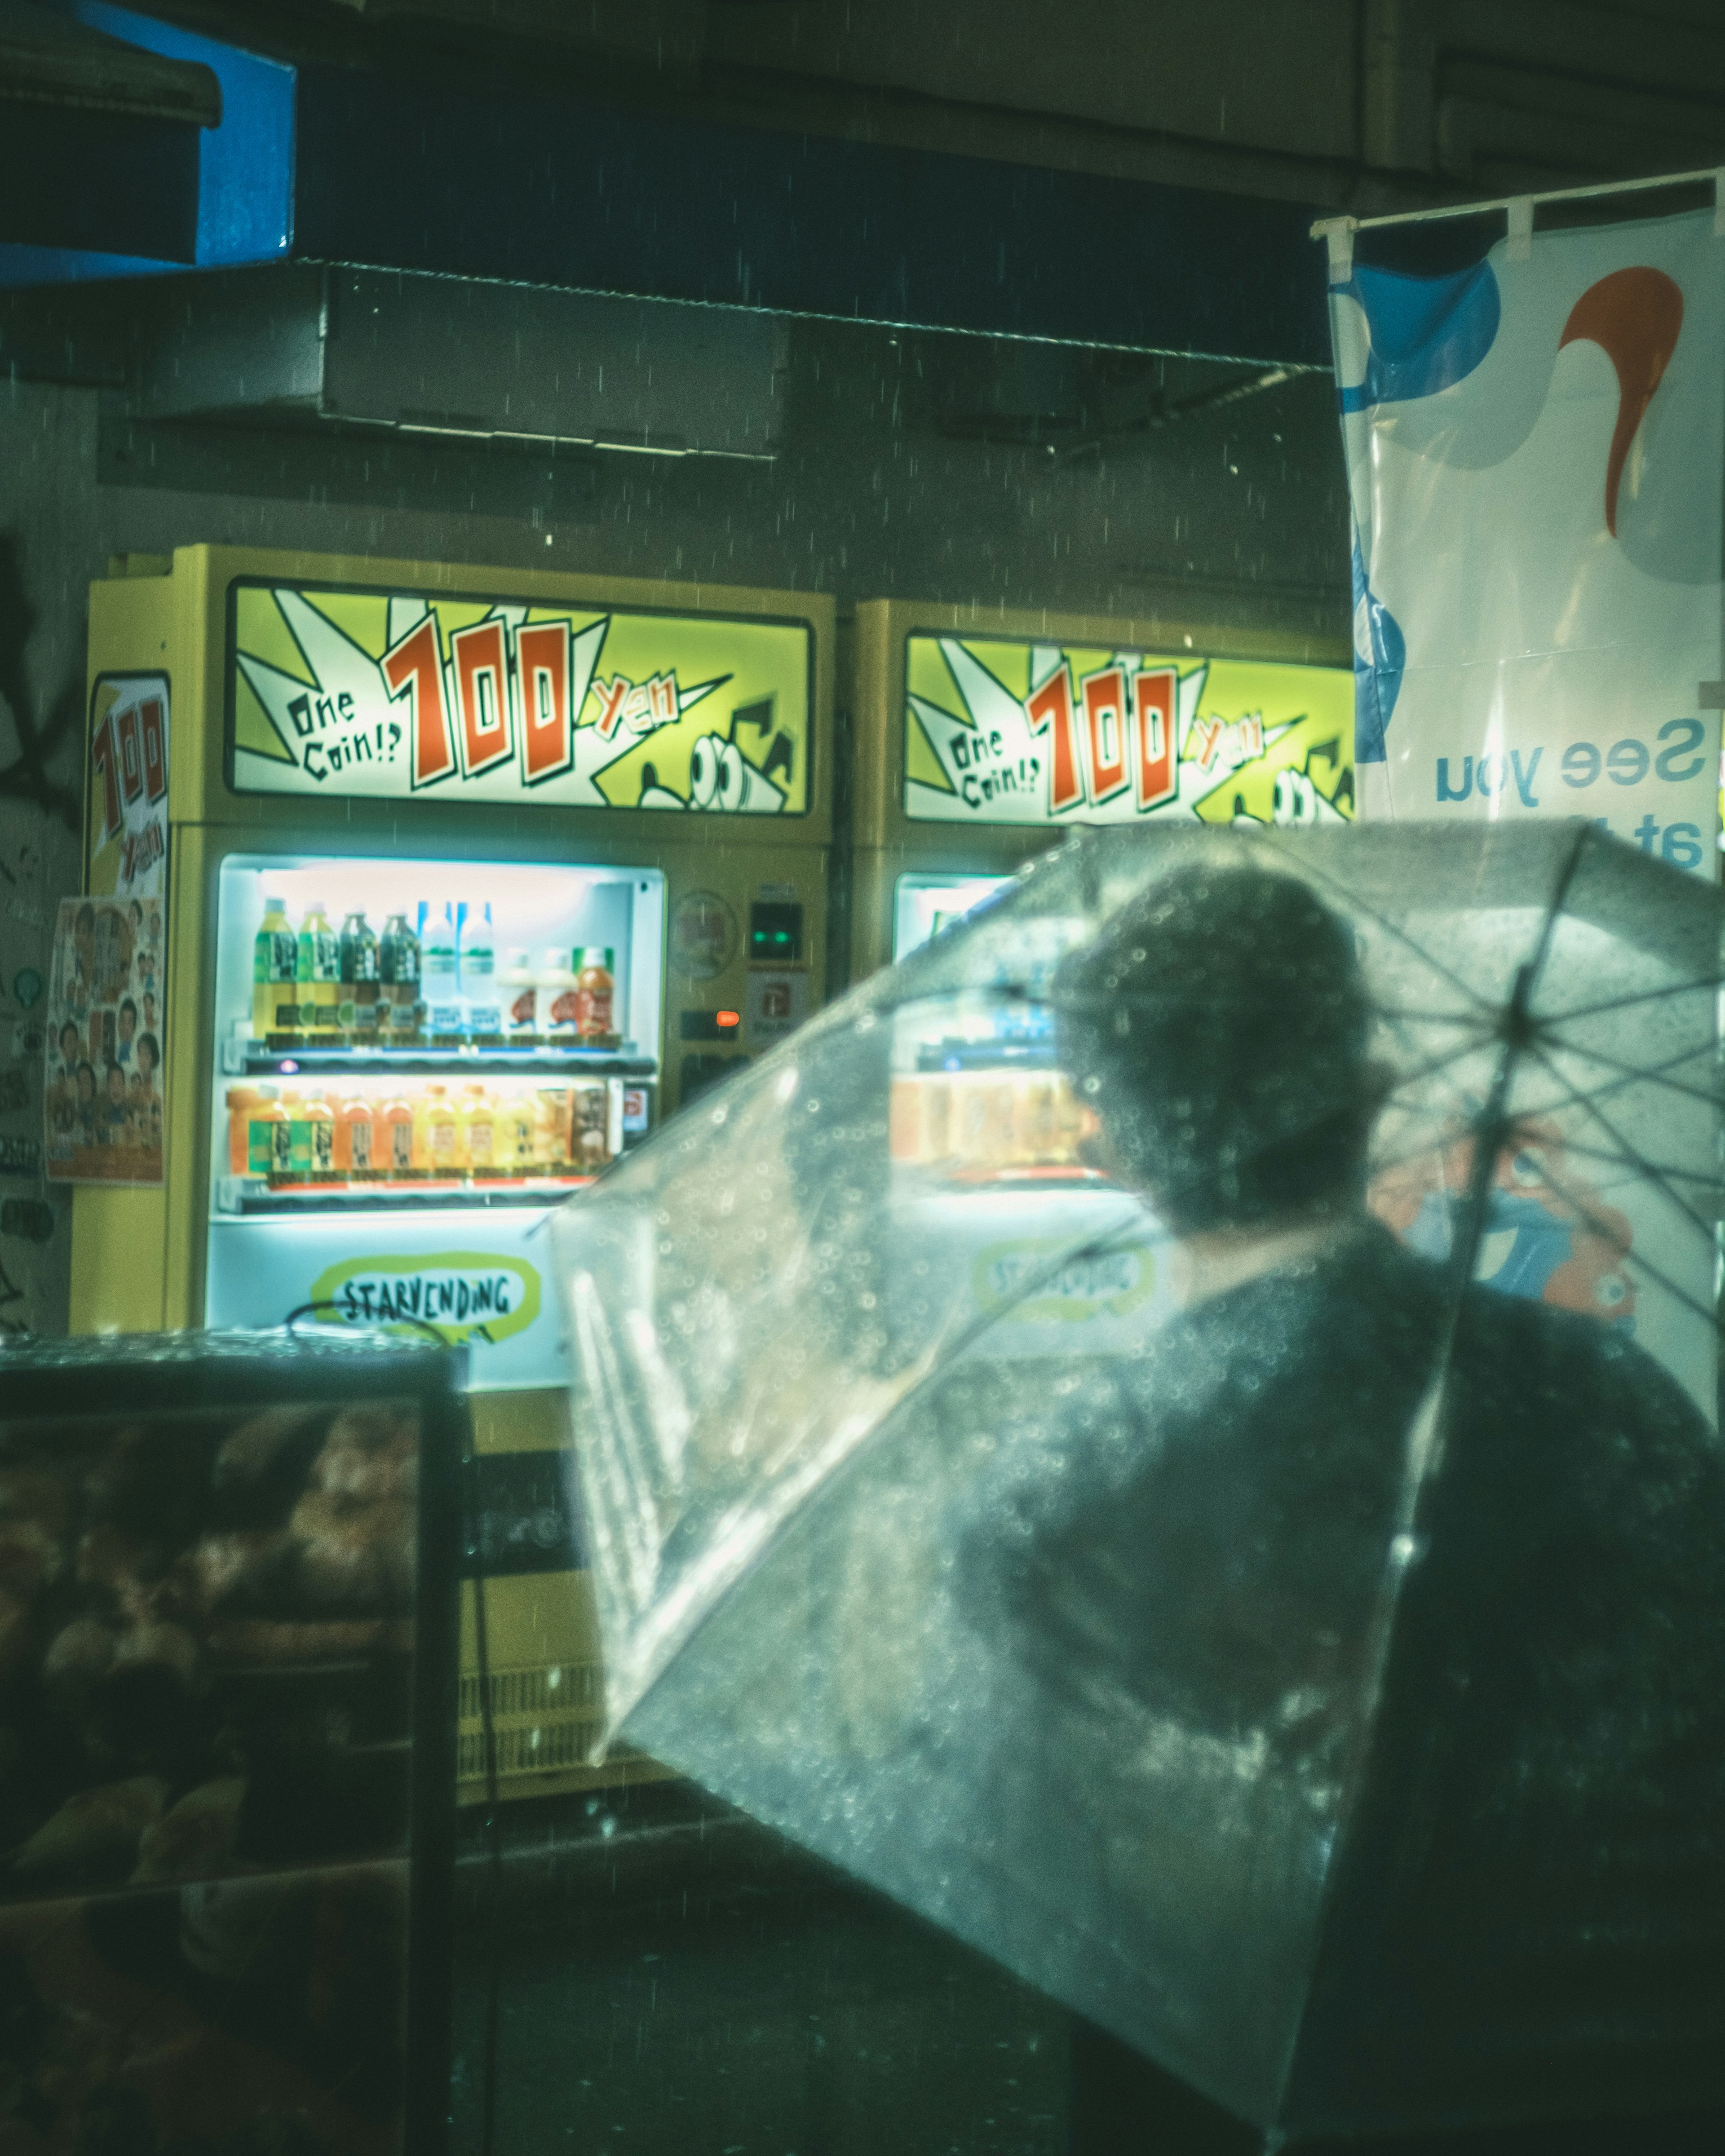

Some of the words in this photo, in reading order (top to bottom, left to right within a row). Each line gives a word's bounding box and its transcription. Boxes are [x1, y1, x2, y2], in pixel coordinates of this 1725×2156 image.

[287, 692, 355, 737] One
[378, 608, 573, 791] 100
[590, 669, 682, 743] yen
[949, 730, 1004, 770] One
[1023, 656, 1180, 816] 100
[93, 695, 166, 838] 100
[303, 723, 402, 782] Coin!?
